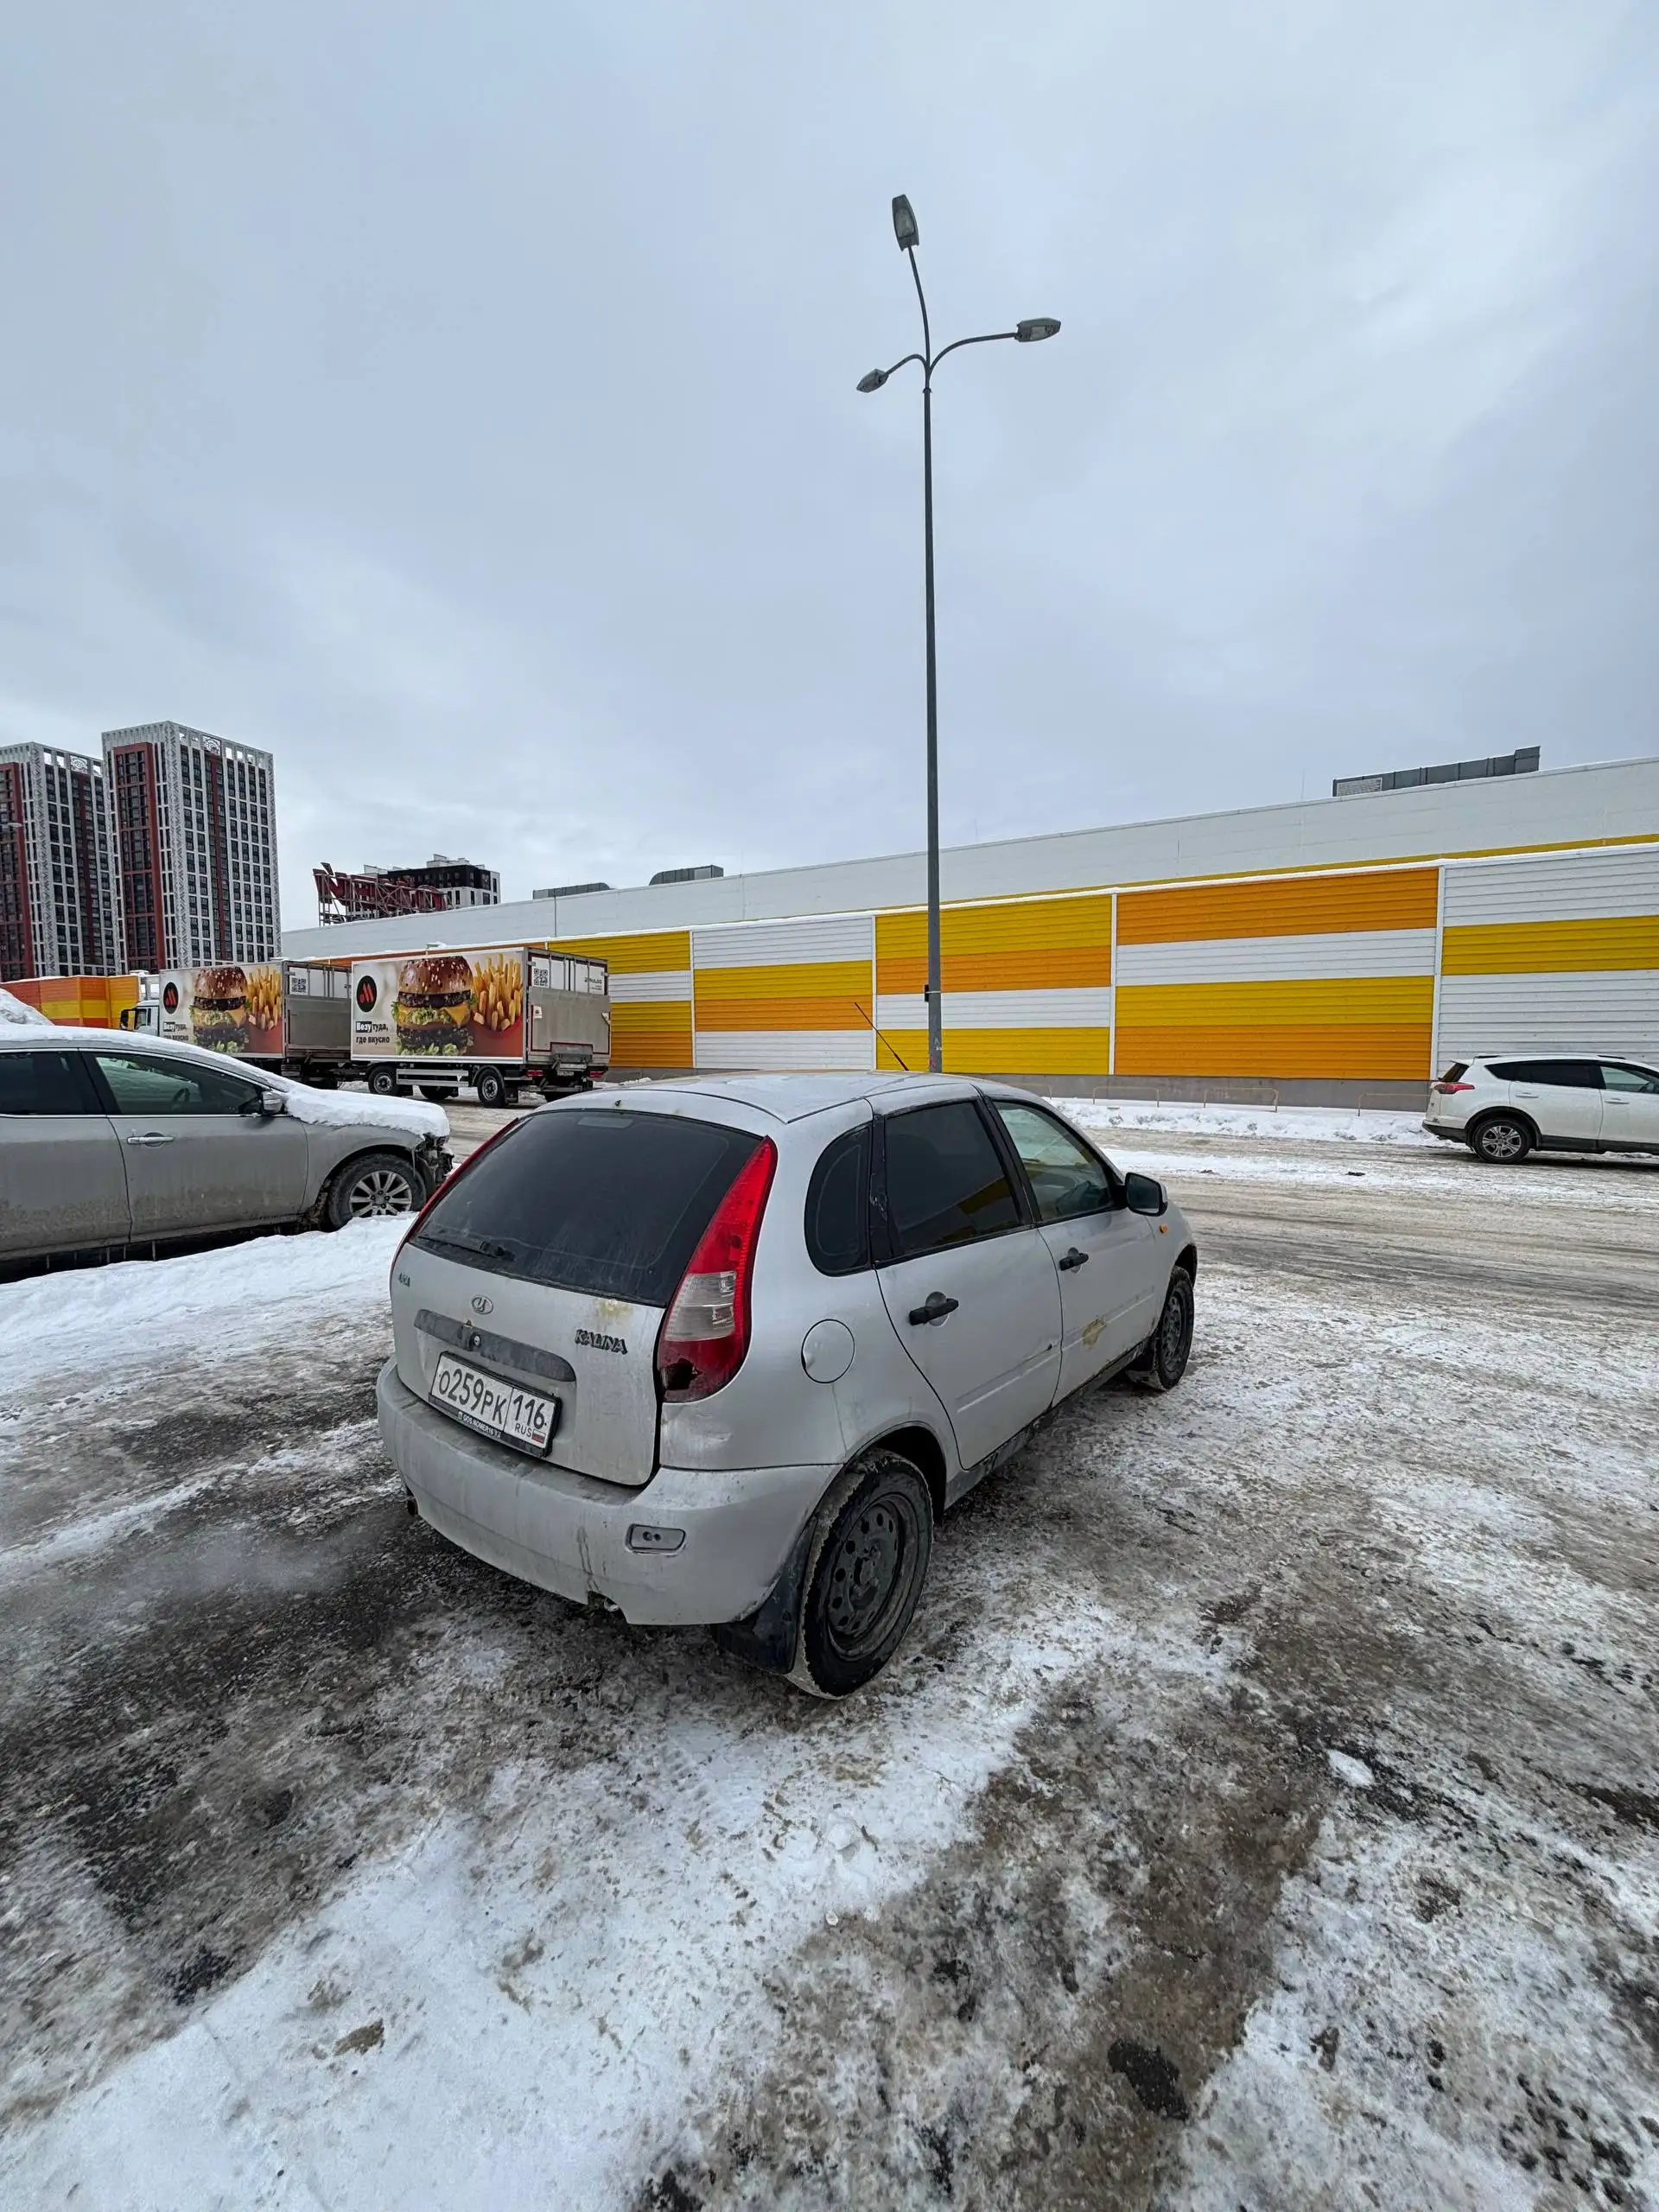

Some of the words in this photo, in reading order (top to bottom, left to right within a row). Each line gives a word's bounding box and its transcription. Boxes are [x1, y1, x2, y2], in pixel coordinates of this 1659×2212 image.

[356, 1022, 372, 1033] Везу
[373, 1024, 388, 1033] туда,
[575, 1329, 627, 1355] KALINA
[513, 1394, 546, 1430] 116
[514, 1422, 532, 1438] RUS
